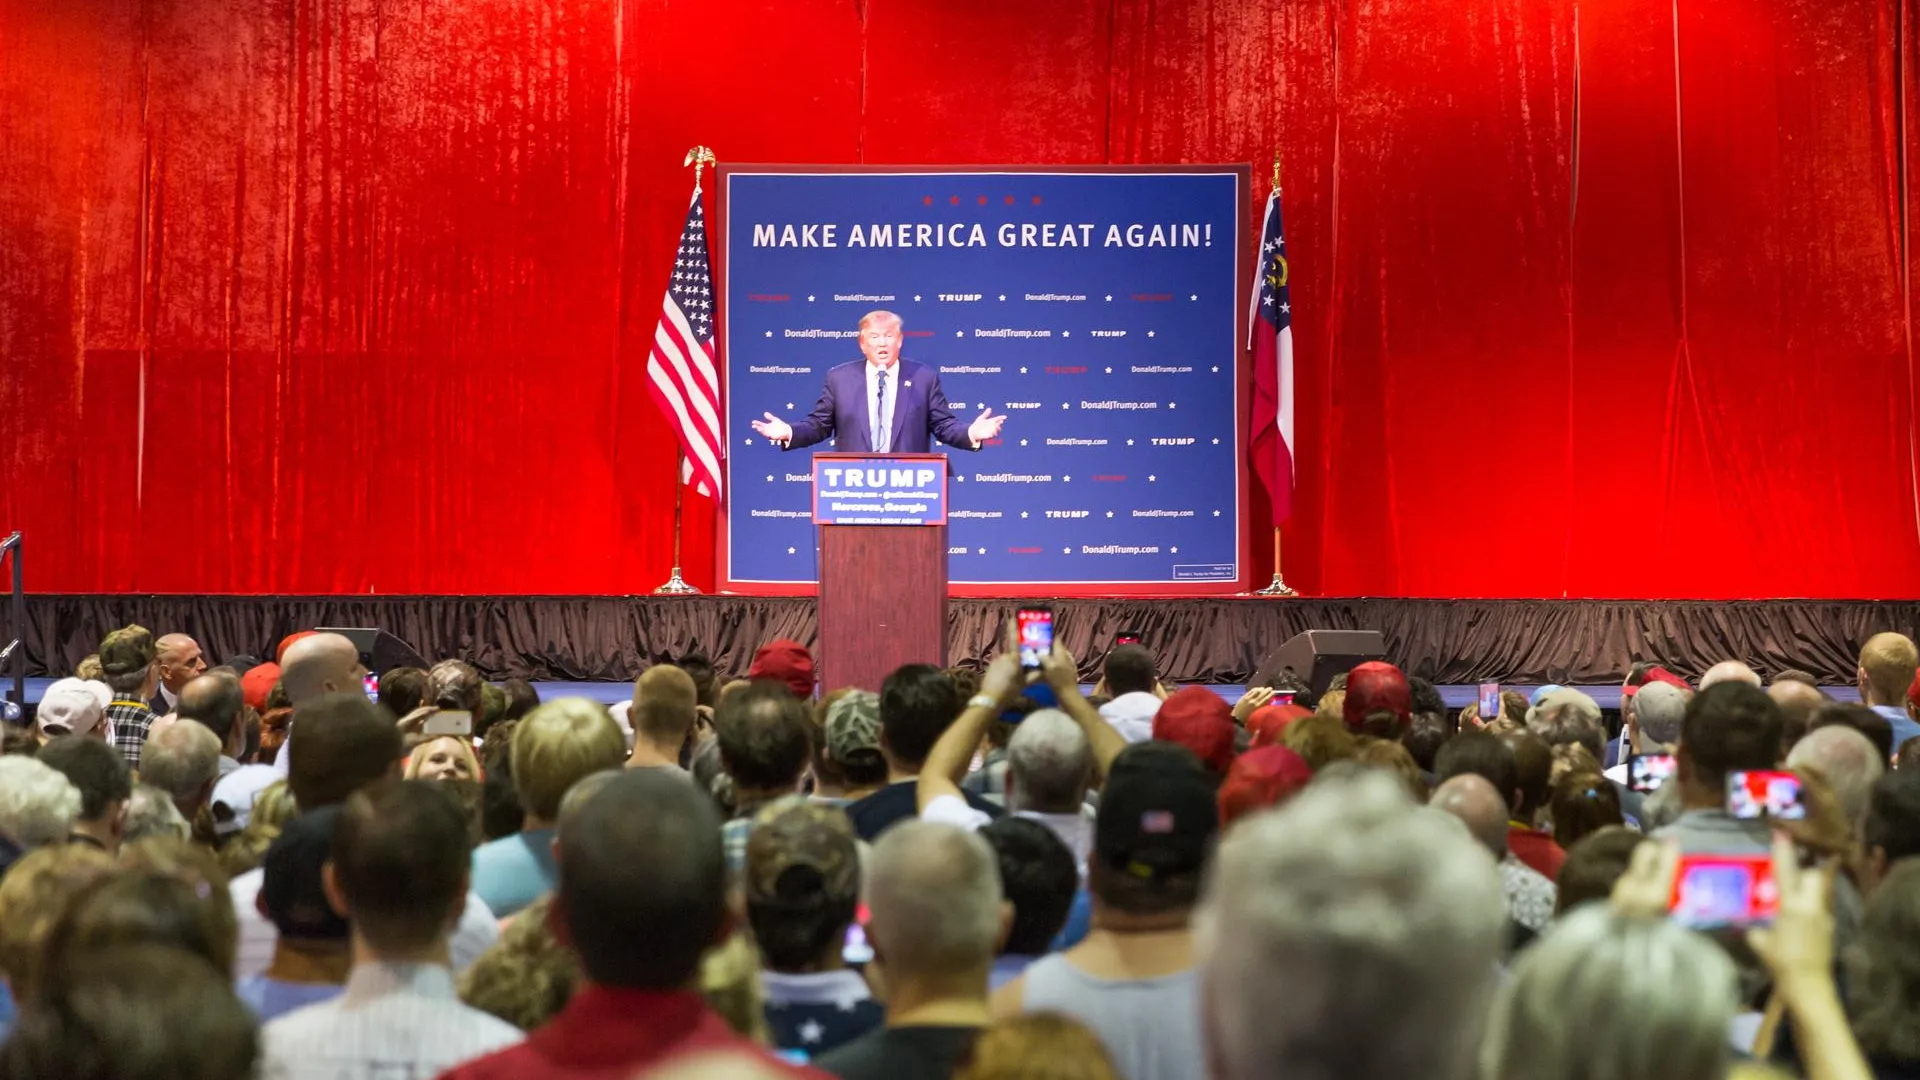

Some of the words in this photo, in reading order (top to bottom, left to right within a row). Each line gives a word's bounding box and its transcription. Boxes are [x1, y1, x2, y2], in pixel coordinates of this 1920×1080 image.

[752, 223, 837, 248] MAKE
[847, 223, 987, 248] AMERICA
[997, 223, 1095, 248] GREAT
[1103, 223, 1212, 247] AGAIN!
[833, 293, 896, 303] DonaldJTrump.com
[937, 293, 983, 302] TRUMP
[1024, 293, 1087, 302] DonaldJTrump.com
[784, 328, 860, 340] DonaldJTrump.com
[974, 328, 1051, 340] DonaldJTrump.com
[1090, 330, 1127, 338] TRUMP
[749, 365, 812, 374] DonaldJTrump.com
[939, 365, 1002, 374] DonaldJTrump.com
[1131, 365, 1193, 374] DonaldJTrump.com
[1005, 402, 1042, 410] TRUMP
[1080, 400, 1157, 412] DonaldJTrump.com
[1046, 437, 1108, 446] DonaldJTrump.com
[1150, 437, 1196, 446] TRUMP
[824, 468, 936, 488] TRUMP
[974, 472, 1052, 484] DonaldJTrump.com
[884, 502, 928, 513] Georgia
[751, 509, 812, 519] DonaldJTrump.com
[1044, 510, 1090, 519] TRUMP
[1132, 509, 1194, 518] DonaldJTrump.com
[1081, 544, 1159, 556] DonaldJTrump.com
